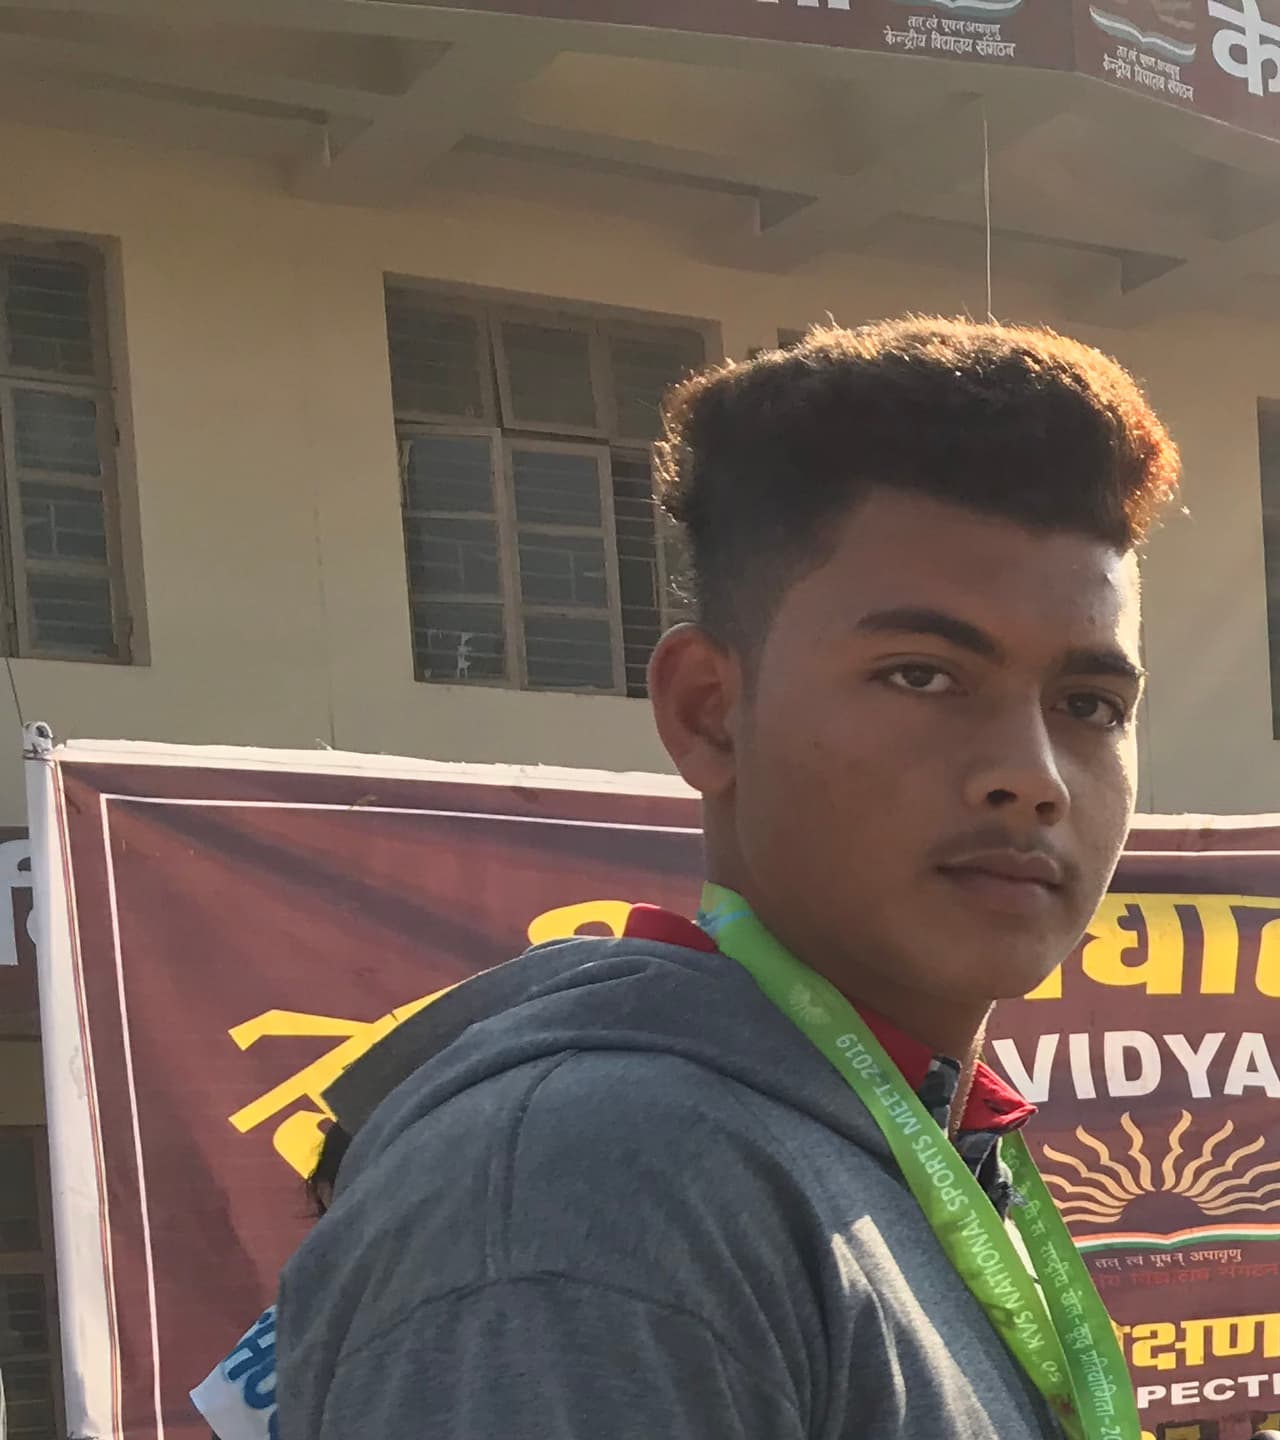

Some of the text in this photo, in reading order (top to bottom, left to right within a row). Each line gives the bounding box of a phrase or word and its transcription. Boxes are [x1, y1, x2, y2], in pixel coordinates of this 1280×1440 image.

[883, 25, 927, 50] केन्द्रीय
[931, 31, 974, 54] विद्यालय
[836, 1033, 921, 1135] MEET-2019
[912, 1135, 969, 1210] SPORTS
[956, 1209, 1026, 1310] NATIONAL
[1012, 1311, 1046, 1349] KVS
